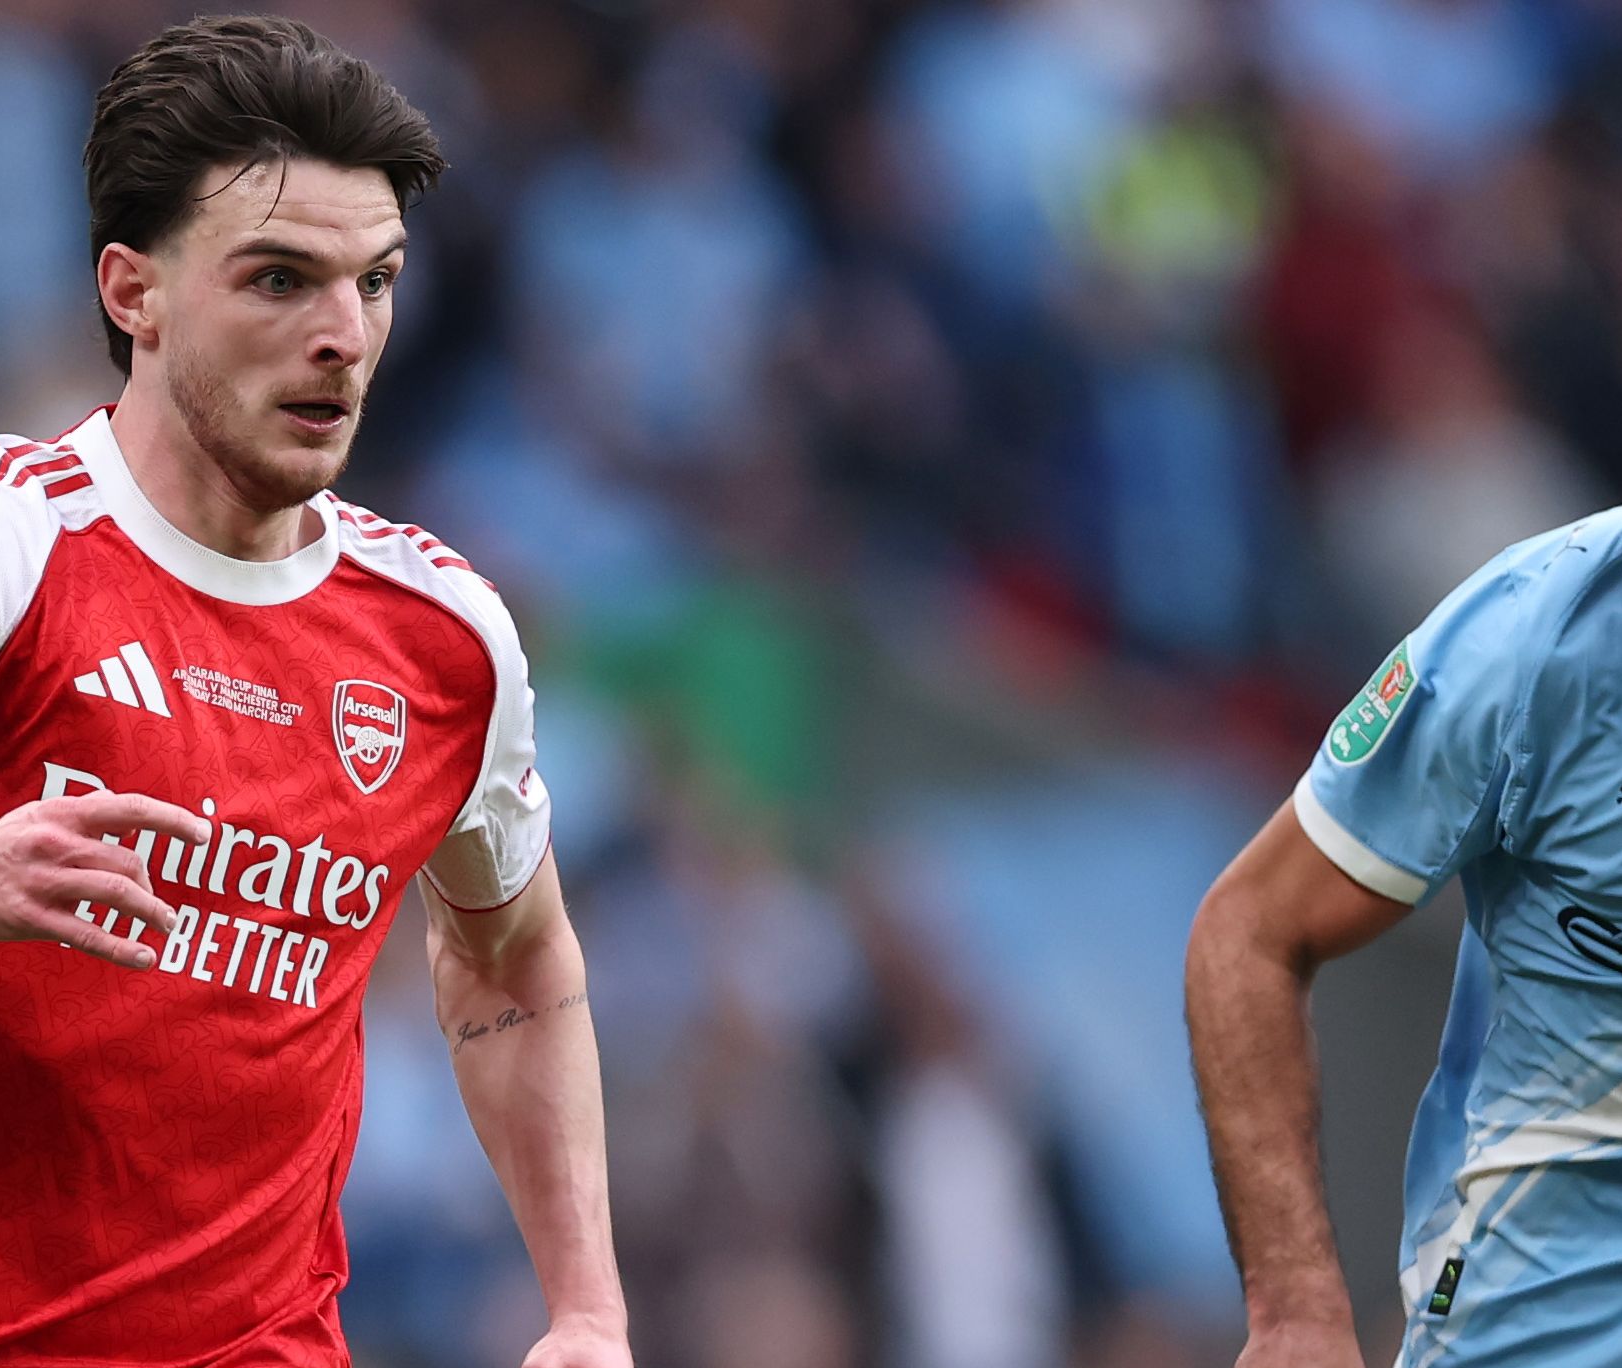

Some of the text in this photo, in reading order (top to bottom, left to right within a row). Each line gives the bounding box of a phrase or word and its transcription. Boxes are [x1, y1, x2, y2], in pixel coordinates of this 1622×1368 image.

[172, 668, 209, 692] ARNAL
[209, 681, 218, 692] V
[280, 702, 304, 717] CITY
[182, 681, 293, 726] SNDAY 22ND MARCH 2026
[232, 678, 252, 692] CUP
[252, 684, 279, 700] FINAL
[343, 696, 396, 726] Arsenal
[158, 903, 330, 1009] BETTER
